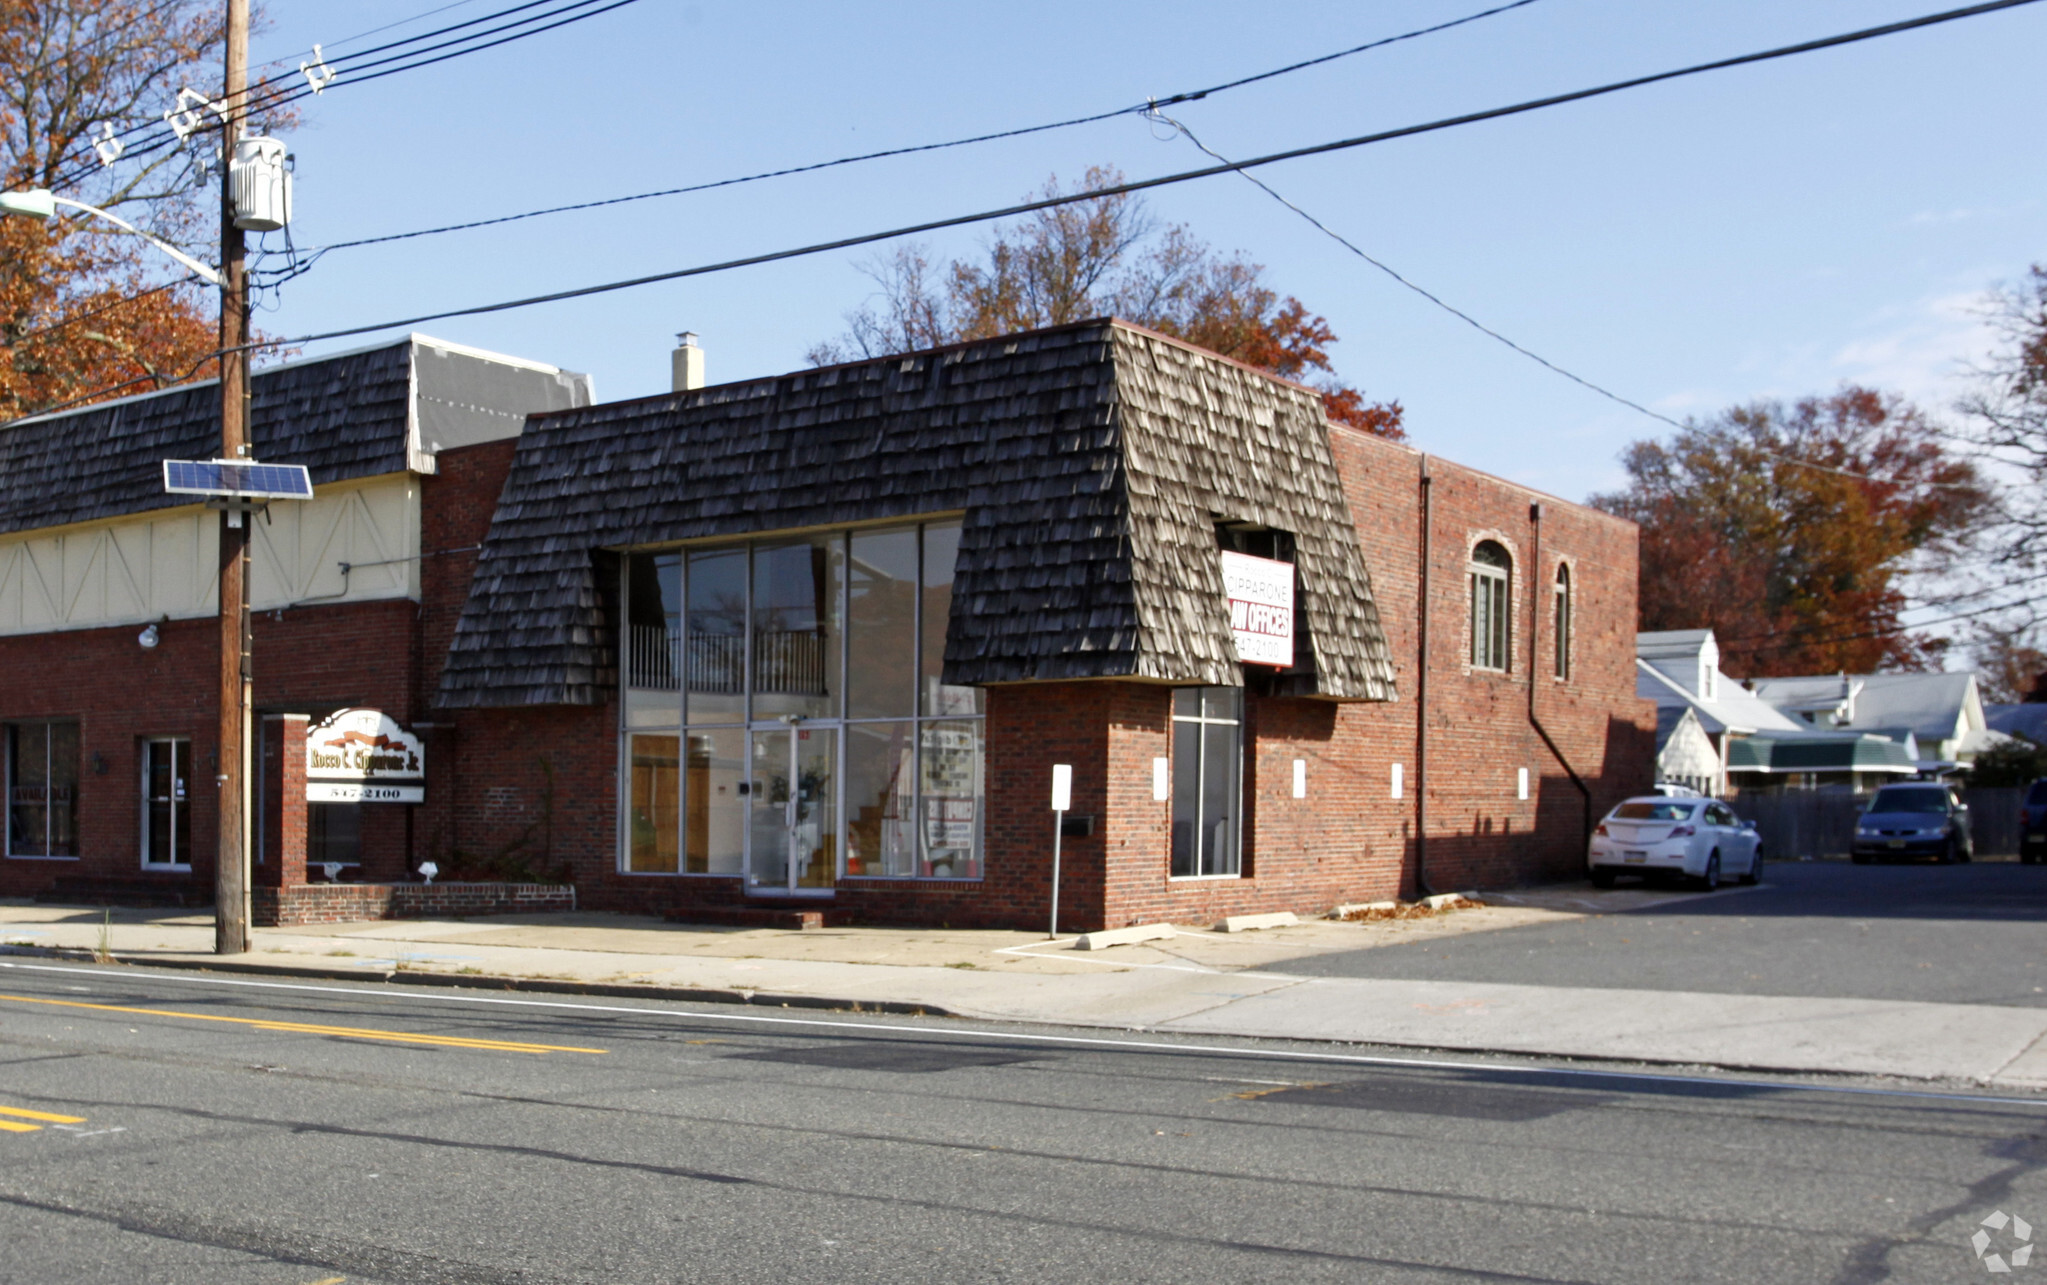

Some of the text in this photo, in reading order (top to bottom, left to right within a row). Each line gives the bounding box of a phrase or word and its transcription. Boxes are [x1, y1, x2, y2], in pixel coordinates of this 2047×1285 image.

[1227, 575, 1288, 602] CIPPARONE
[1230, 600, 1288, 636] AW OFFICES
[311, 748, 341, 769] Rocco
[342, 748, 352, 769] C.
[330, 788, 400, 799] 547-2100
